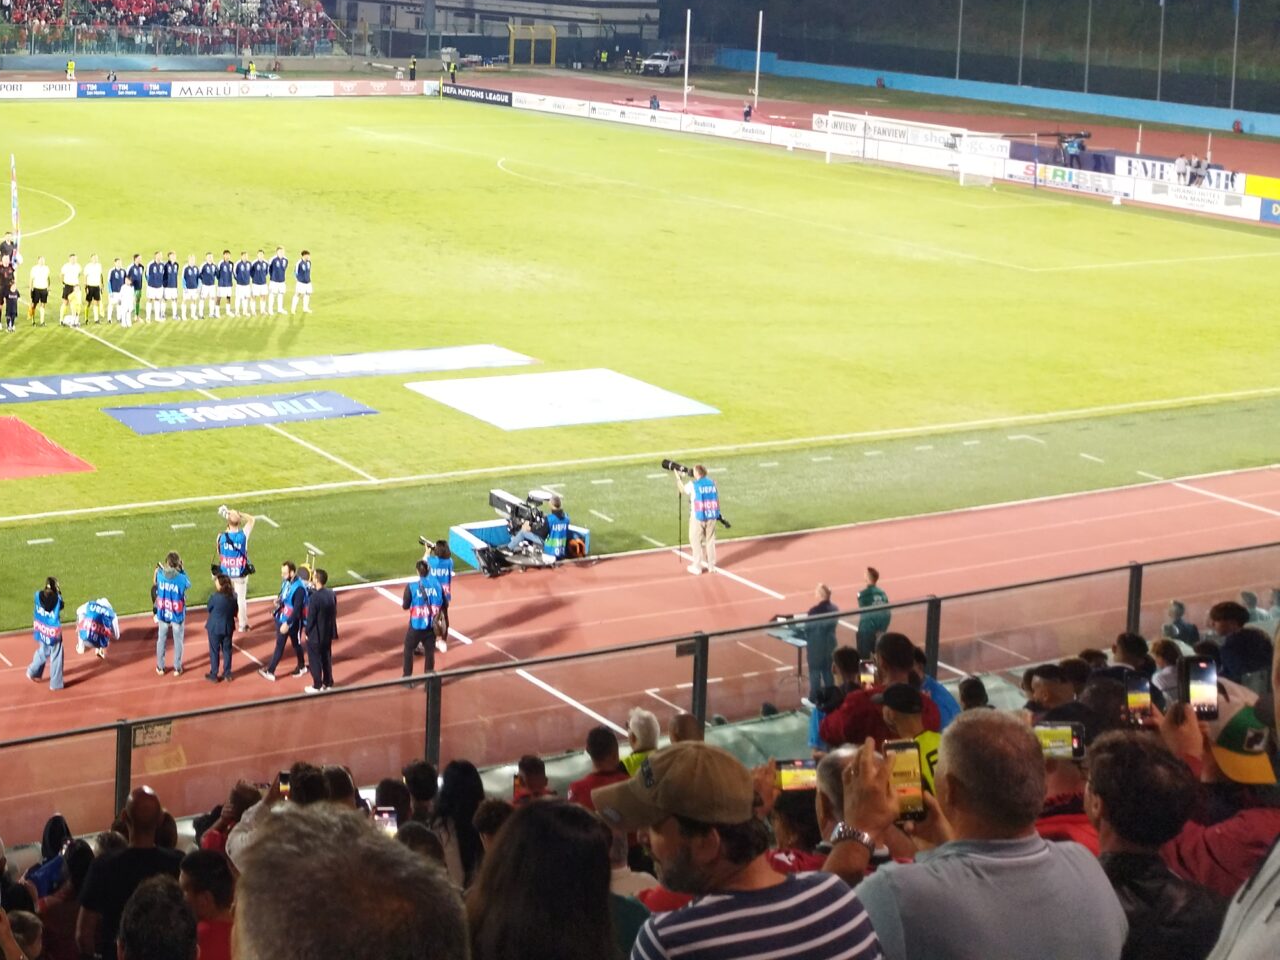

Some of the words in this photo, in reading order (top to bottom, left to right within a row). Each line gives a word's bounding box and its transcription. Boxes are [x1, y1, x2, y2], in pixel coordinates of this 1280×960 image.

[179, 83, 231, 96] MARLÙ
[443, 86, 457, 96] UEFA
[458, 88, 484, 100] NATIONS
[485, 92, 509, 103] LEAGUE
[873, 126, 906, 139] FANVIEW
[1023, 164, 1115, 187] SERISET
[0, 365, 262, 399] NATIONS
[698, 486, 717, 494] UEFA
[430, 567, 449, 576] UEFA
[159, 580, 179, 594] UEFA
[89, 603, 111, 618] UEFA
[33, 620, 56, 637] PHOTO
